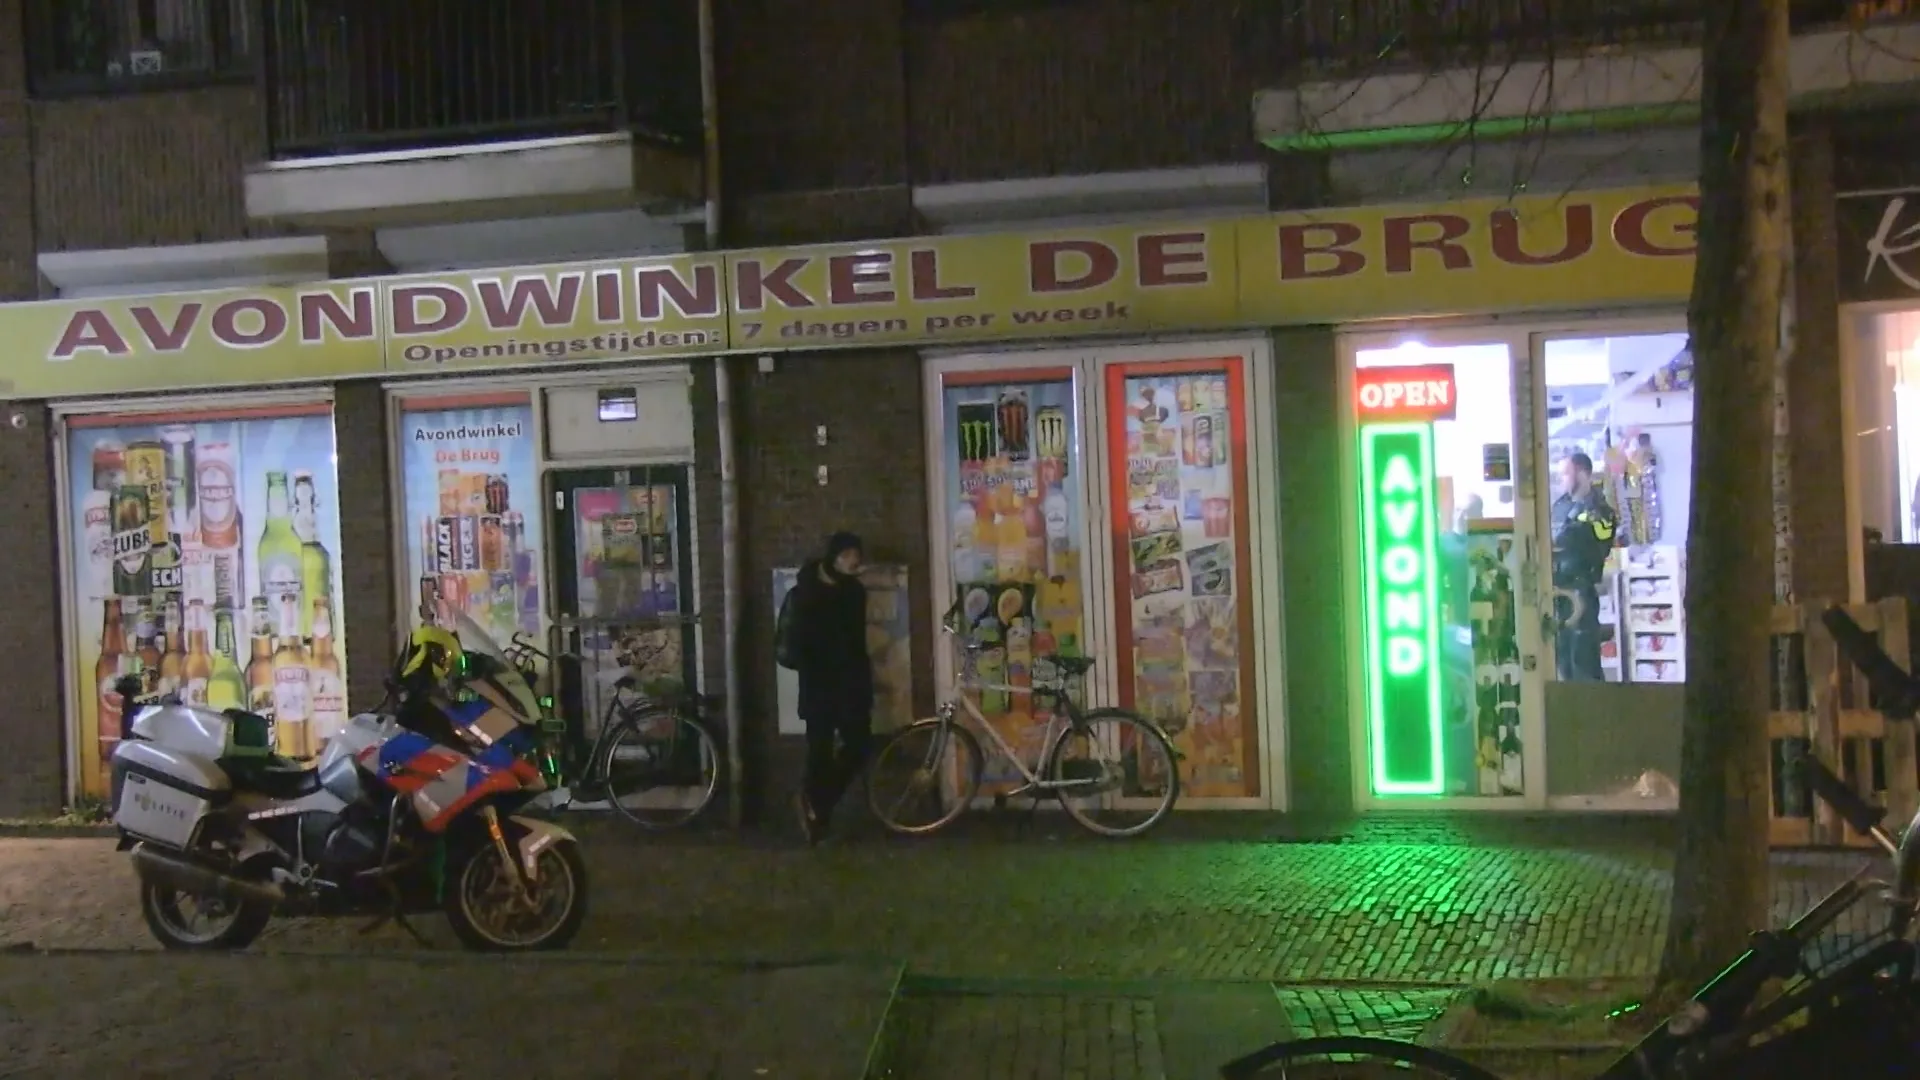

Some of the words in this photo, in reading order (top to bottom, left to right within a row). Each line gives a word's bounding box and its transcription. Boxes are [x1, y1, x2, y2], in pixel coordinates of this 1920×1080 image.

[50, 249, 977, 358] AVONDWINKEL
[1029, 232, 1208, 292] DE
[1279, 195, 1698, 281] BRUG
[404, 327, 720, 365] Openingstijden:
[742, 322, 762, 339] 7
[780, 317, 908, 341] dagen
[925, 311, 994, 335] per
[1012, 300, 1130, 326] week
[1360, 379, 1450, 409] OPEN
[415, 422, 522, 442] Avondwinkel
[435, 450, 458, 464] De
[461, 448, 500, 465] Brug
[1380, 453, 1423, 676] AVOND
